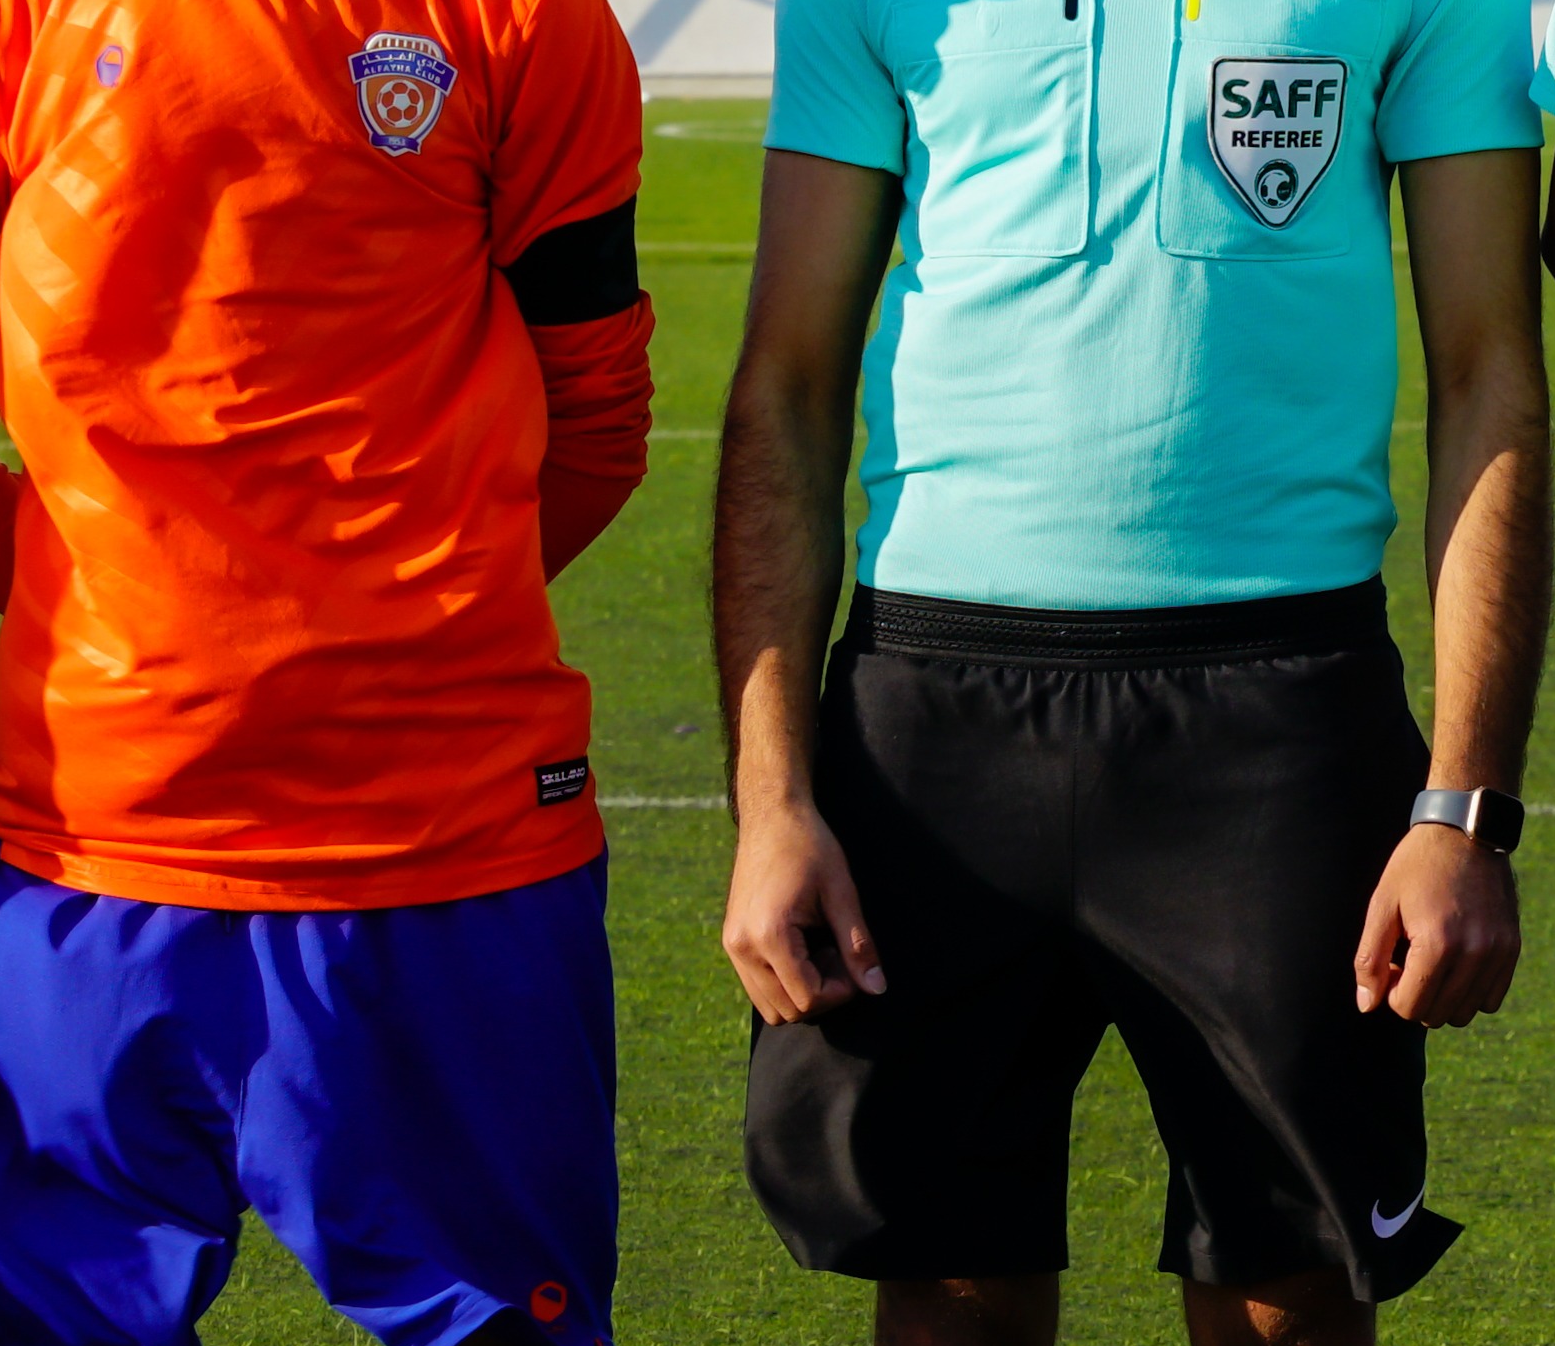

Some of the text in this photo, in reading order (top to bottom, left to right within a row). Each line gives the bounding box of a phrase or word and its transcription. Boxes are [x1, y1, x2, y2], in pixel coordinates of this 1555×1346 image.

[415, 68, 441, 85] CLUB
[1222, 79, 1338, 119] SAFF
[1232, 130, 1323, 148] REFEREE
